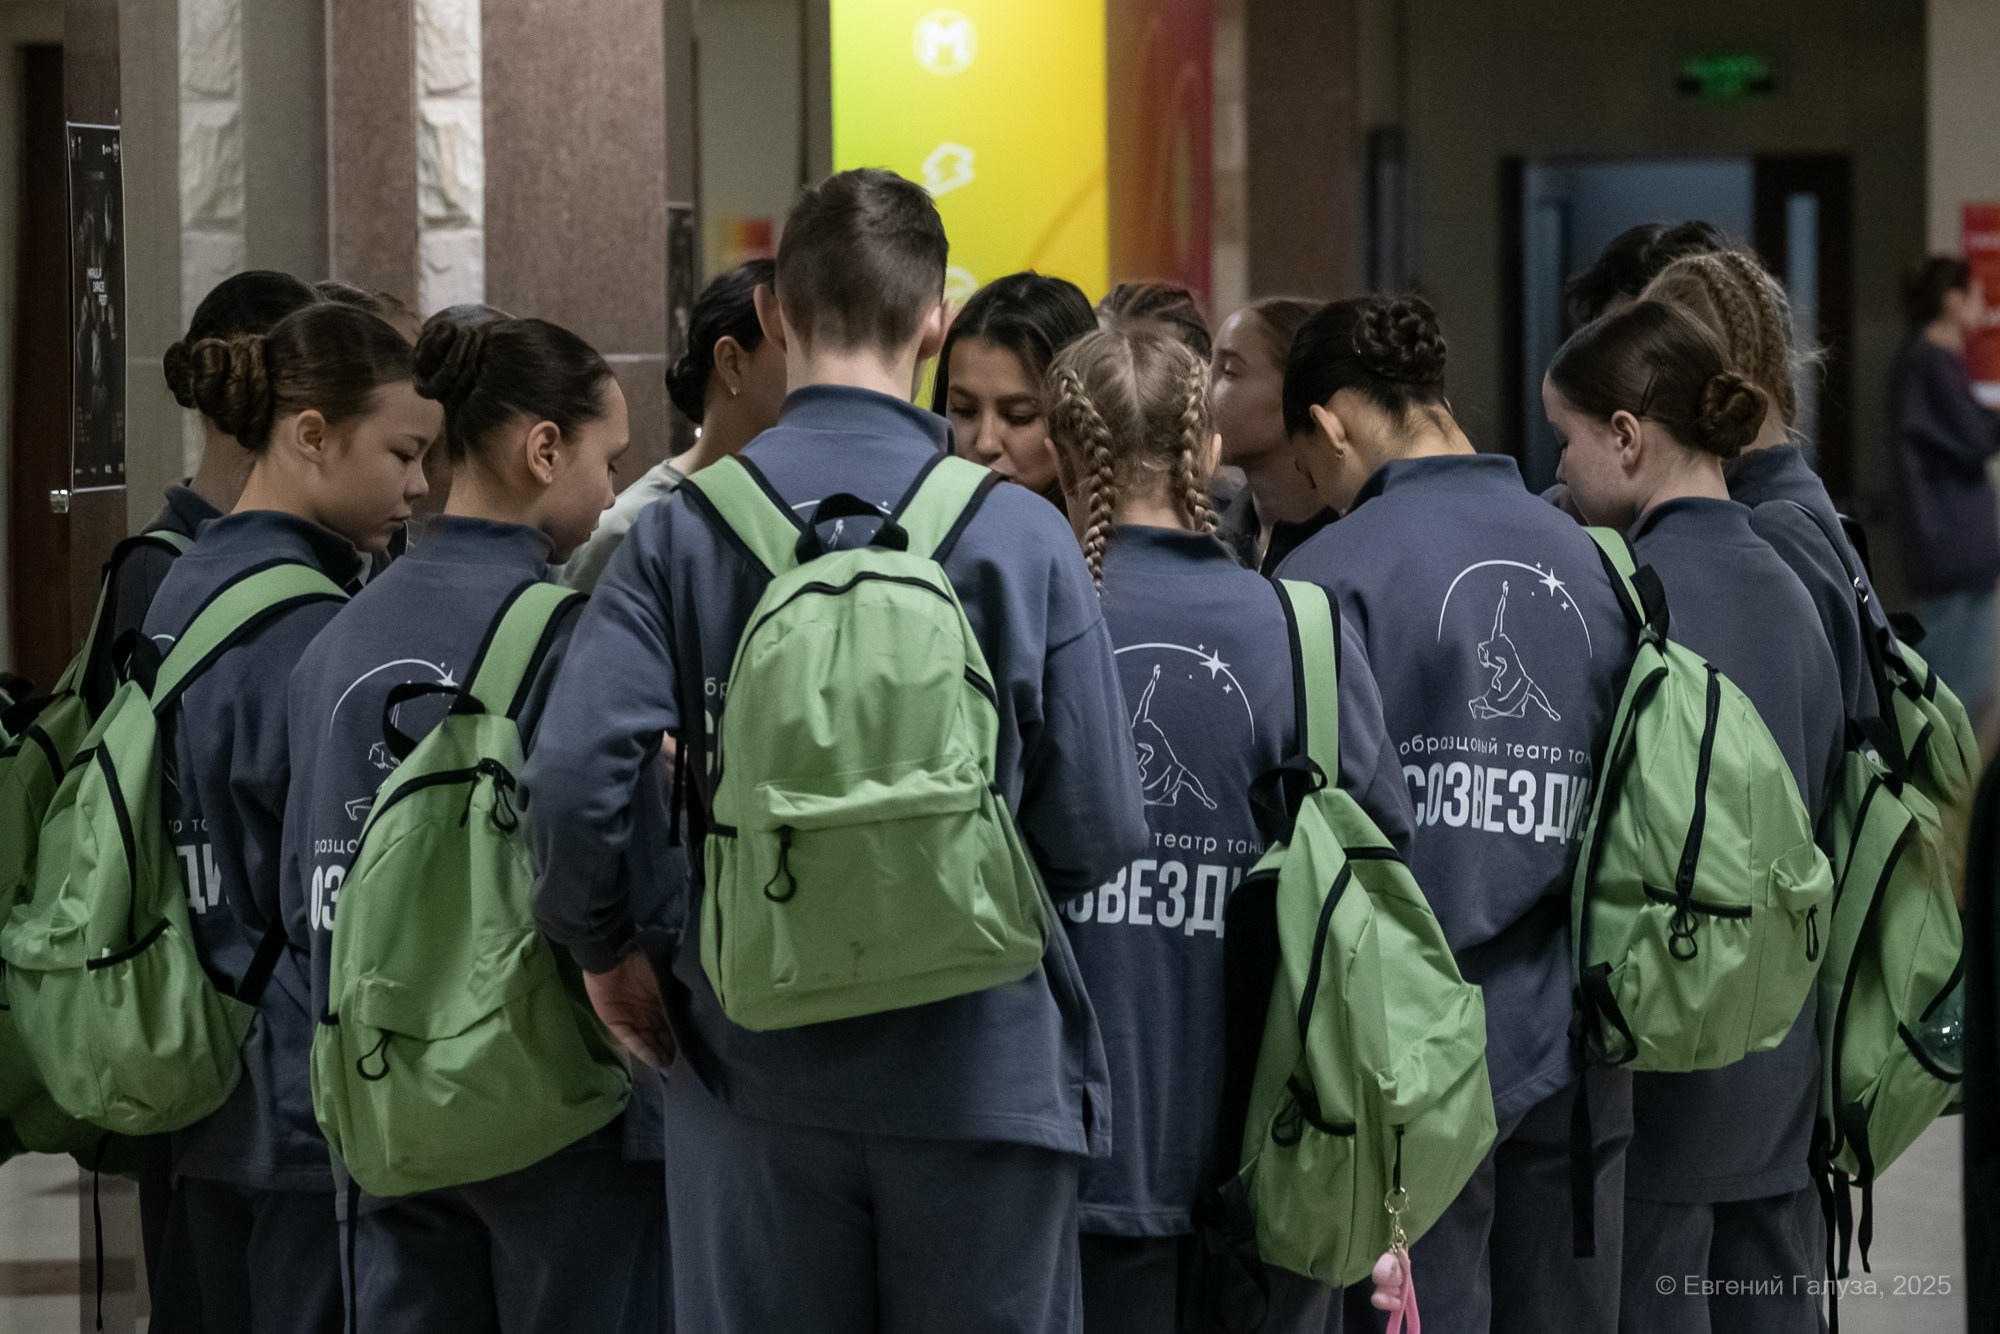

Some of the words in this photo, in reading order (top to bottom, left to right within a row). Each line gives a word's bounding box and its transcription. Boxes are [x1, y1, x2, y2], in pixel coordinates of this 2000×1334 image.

[1400, 734, 1498, 756] образцовый
[1506, 742, 1562, 765] театр
[1154, 831, 1217, 854] театр
